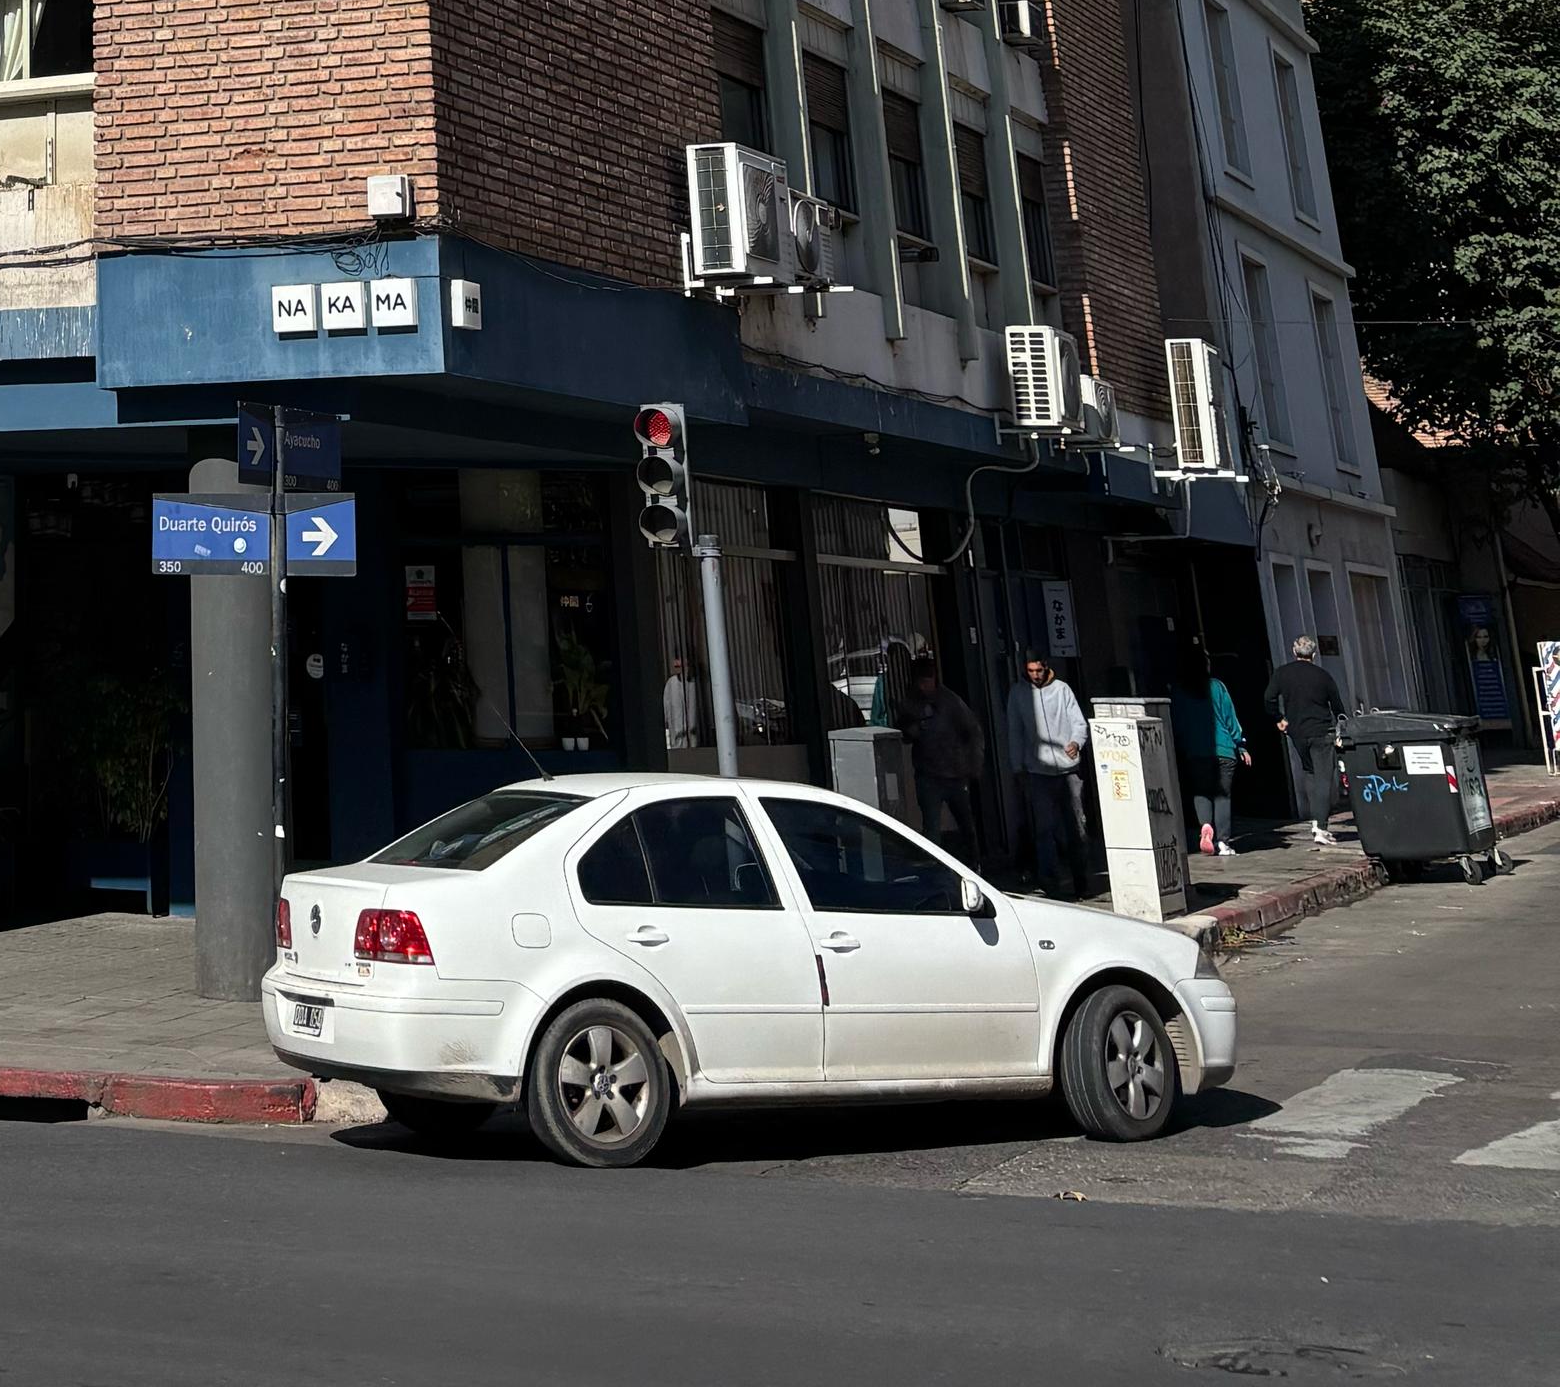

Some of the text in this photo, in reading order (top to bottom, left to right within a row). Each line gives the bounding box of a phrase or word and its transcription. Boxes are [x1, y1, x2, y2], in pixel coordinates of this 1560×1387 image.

[278, 293, 406, 317] NA KA MA
[284, 431, 321, 449] Ayacucho
[284, 475, 297, 487] 300
[159, 516, 257, 533] Duarte Quirós
[159, 561, 263, 574] 350 400
